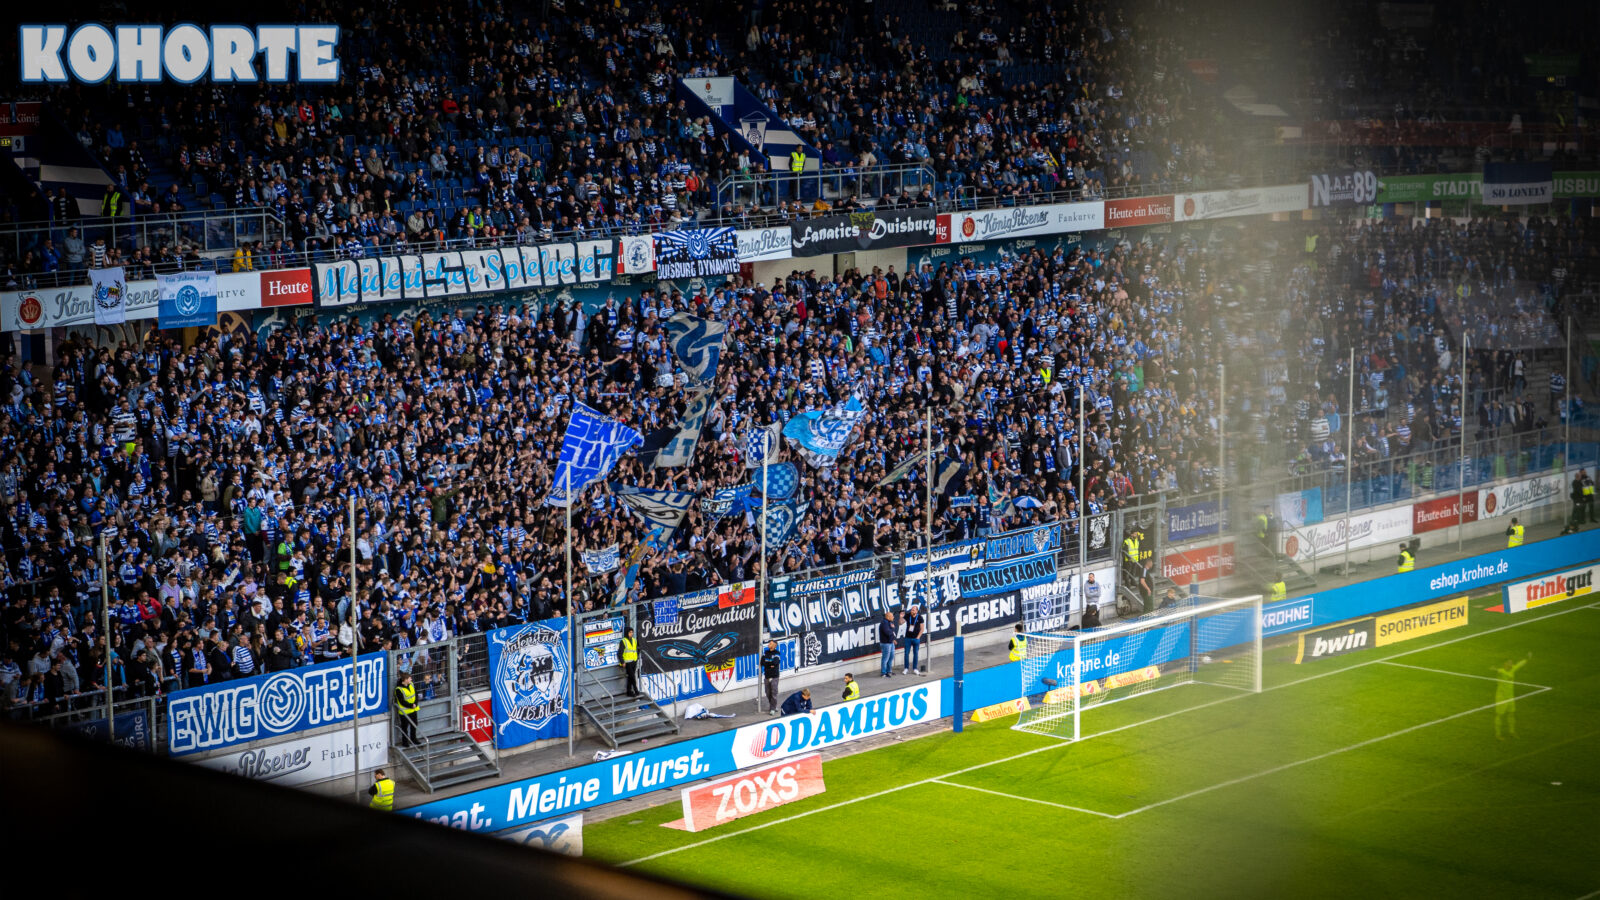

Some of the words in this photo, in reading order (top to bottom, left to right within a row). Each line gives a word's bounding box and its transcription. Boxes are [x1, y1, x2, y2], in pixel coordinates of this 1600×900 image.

[1353, 170, 1377, 203] 89
[1492, 187, 1506, 199] SO
[1508, 185, 1548, 198] LONELY
[980, 212, 1012, 235] König
[1058, 211, 1096, 223] Fankurve
[1109, 207, 1133, 220] Heute
[1133, 207, 1147, 218] ein
[1148, 203, 1171, 220] König
[737, 238, 761, 257] önig
[760, 229, 792, 250] Pilsen
[792, 221, 861, 249] Fanatics
[867, 215, 937, 241] Duisburg
[320, 256, 479, 297] Meidericher
[486, 249, 613, 288] Spielverein
[657, 260, 697, 280] DUISBURG
[699, 257, 741, 276] DYNAMITES
[268, 280, 310, 297] Heute
[53, 289, 96, 321] Köni
[1417, 511, 1439, 523] Heute
[1439, 508, 1452, 517] ein
[1452, 501, 1475, 516] Knig
[1336, 519, 1373, 540] Pisener
[959, 556, 1056, 594] WEDAUSTADION
[1163, 564, 1190, 578] Heute
[1192, 560, 1206, 571] ein
[1430, 559, 1509, 590] eshop.krohne.de
[1022, 581, 1070, 601] RUHRPOTT
[1525, 569, 1593, 602] trinkgut
[641, 616, 684, 638] Proud
[686, 604, 757, 634] Generation
[766, 581, 901, 633] KOHORTE
[1380, 605, 1465, 637] SPORTWETTEN
[827, 622, 881, 655] IMME
[955, 594, 1016, 627] GEBEN!
[1024, 615, 1066, 633] KANAKEN
[1311, 628, 1368, 657] bwin
[170, 684, 258, 753] EWIG
[303, 657, 384, 725] TREU
[983, 706, 1014, 720] Sinalco
[463, 714, 491, 732] Heu
[506, 777, 600, 822] Meine
[611, 747, 710, 796] Wurst.
[711, 765, 801, 822] ZOXS
